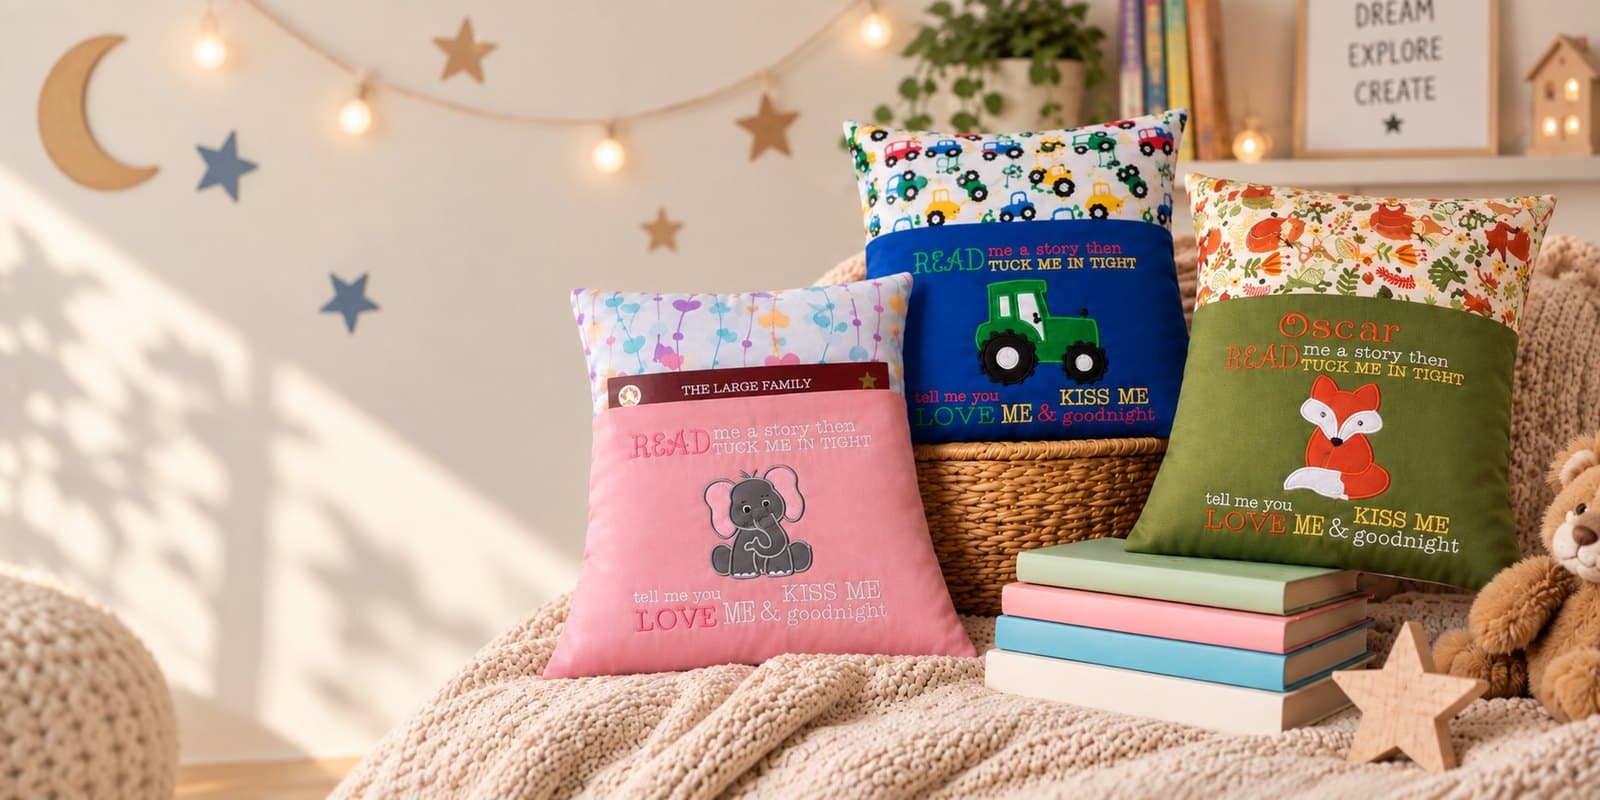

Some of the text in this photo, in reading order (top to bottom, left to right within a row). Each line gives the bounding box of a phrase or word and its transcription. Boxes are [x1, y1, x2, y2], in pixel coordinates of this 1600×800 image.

[1355, 0, 1435, 29] DREAM
[1348, 35, 1443, 68] EXPLORE
[1354, 75, 1437, 106] CREATE
[912, 240, 1122, 275] READ me a story then
[988, 256, 1137, 272] TUCK ME IN TIGHT
[1279, 311, 1401, 344] Oscar
[1225, 343, 1449, 371] READ me a story then
[1301, 358, 1464, 386] TUCK ME IN TIGHT
[681, 378, 813, 396] THE LARGE FAMILY
[915, 390, 1000, 406] tell me you
[1059, 387, 1150, 406] KISS ME
[916, 403, 1156, 427] LOVE ME & goodnight
[630, 419, 856, 459] READ me a story then
[712, 434, 872, 456] TUCK ME IN TIGHT
[1205, 492, 1293, 514] tell me you
[1204, 508, 1460, 555] LOVE ME & goodnight
[1352, 506, 1450, 535] KISS ME
[632, 590, 721, 605] tell me you
[782, 579, 882, 603] KISS ME
[635, 599, 889, 633] LOVE ME & goodnight
